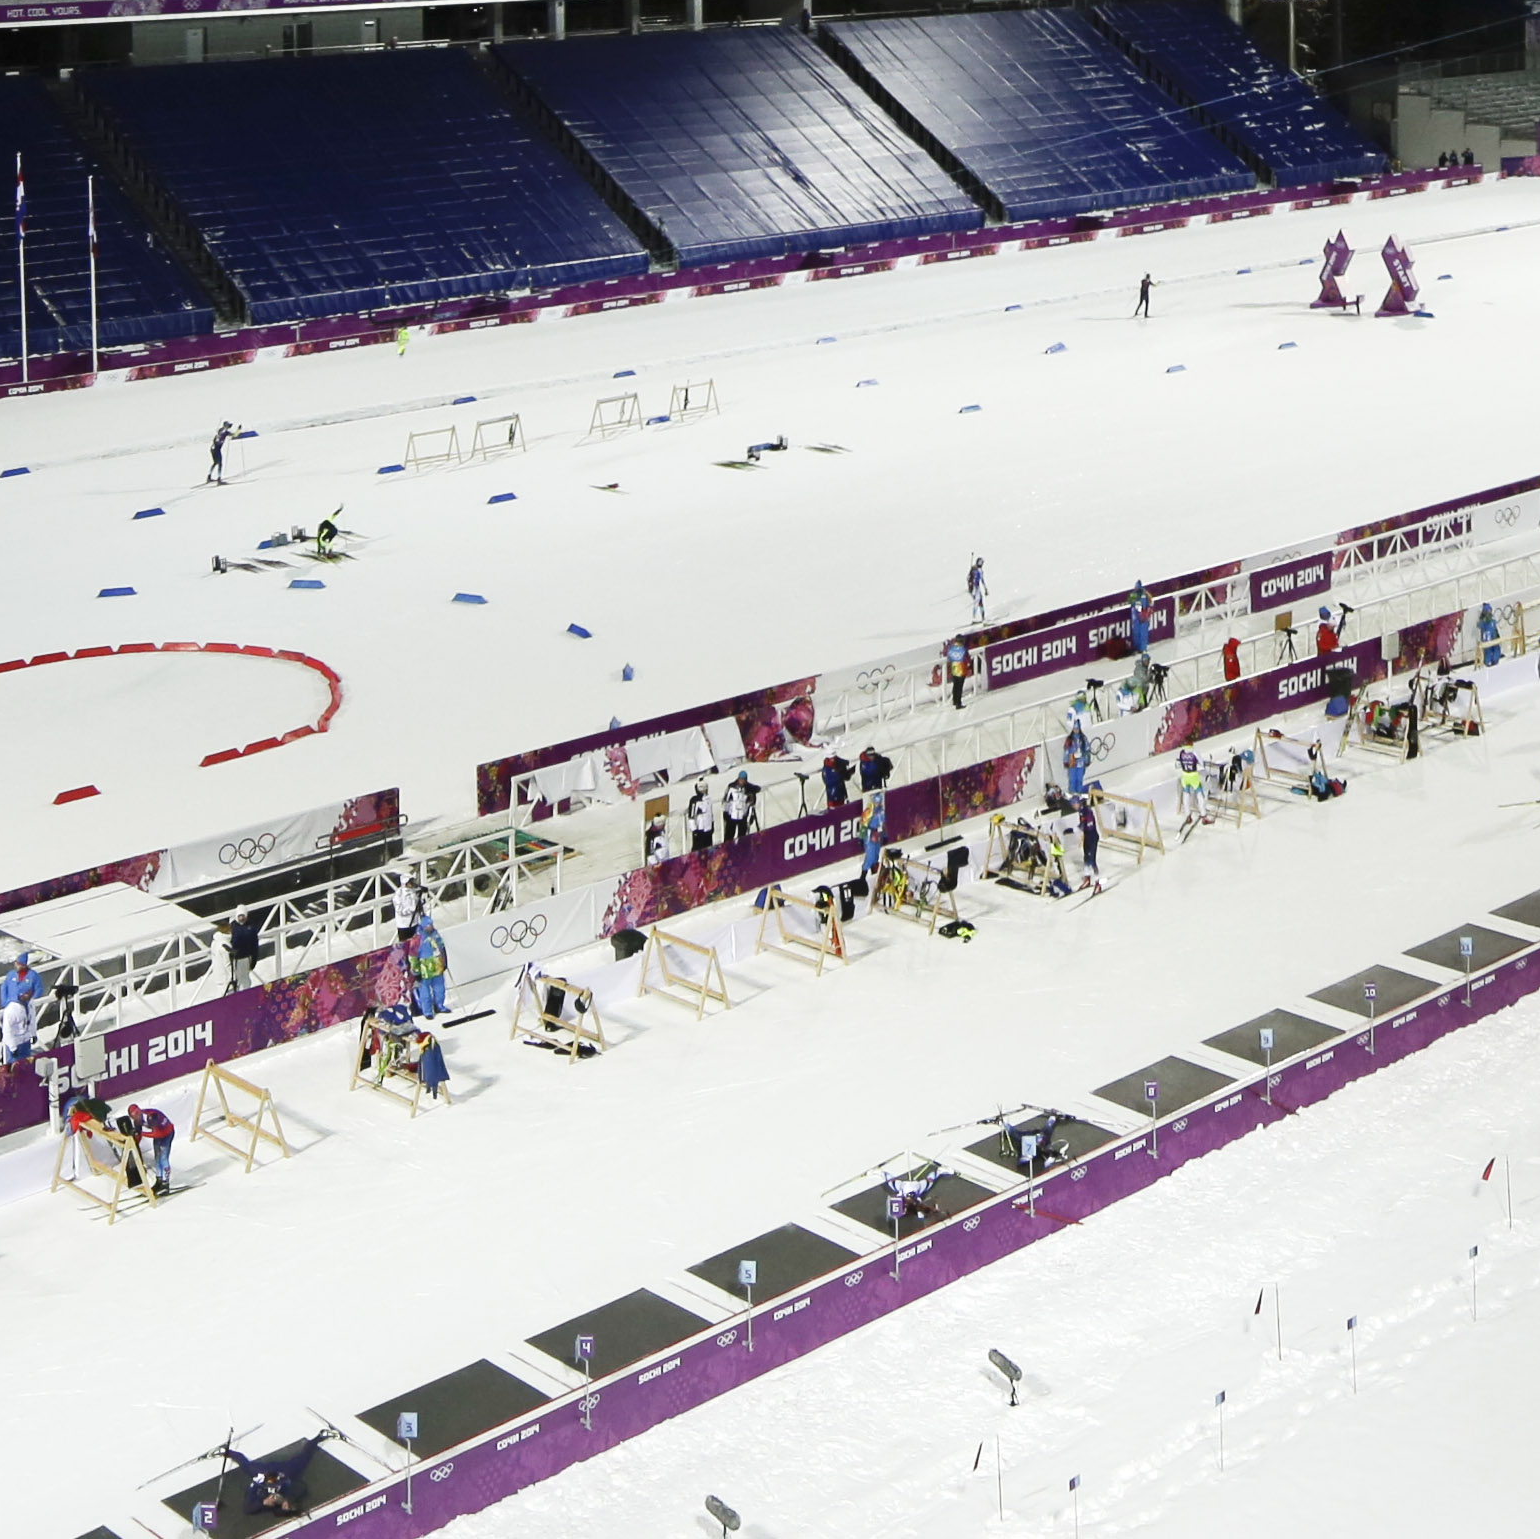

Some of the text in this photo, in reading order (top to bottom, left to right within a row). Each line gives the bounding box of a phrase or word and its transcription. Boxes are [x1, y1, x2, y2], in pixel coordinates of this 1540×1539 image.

[1261, 564, 1324, 598] СОЧИ 2014
[1089, 619, 1130, 649] SOCHI
[992, 635, 1076, 676] SOCHI 2014
[1278, 668, 1321, 700] SOCHI
[783, 824, 835, 860] СОЧИ
[148, 1019, 213, 1066] 2014
[892, 1203, 899, 1212] 6
[745, 1269, 752, 1279] 5
[582, 1342, 591, 1353] 4
[520, 1423, 540, 1440] 2014
[204, 1511, 213, 1524] 2
[336, 1494, 387, 1527] SOCHI 2014
